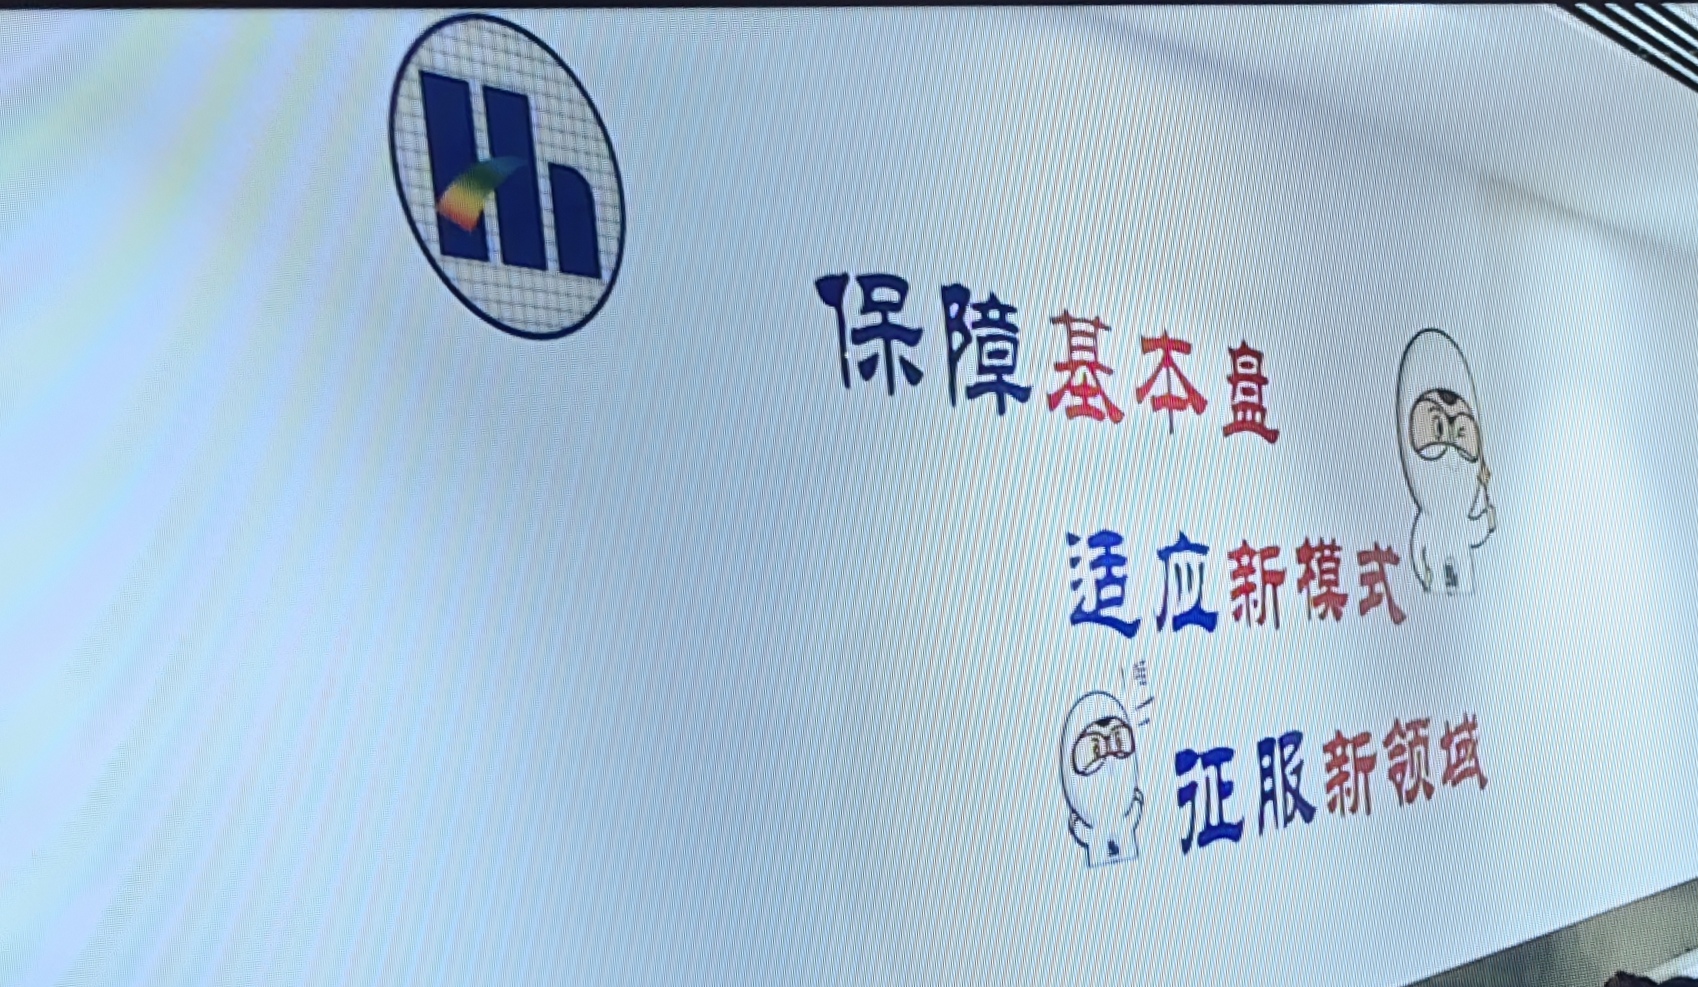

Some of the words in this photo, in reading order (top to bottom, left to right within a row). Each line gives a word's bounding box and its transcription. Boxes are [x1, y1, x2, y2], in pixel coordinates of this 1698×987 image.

[816, 272, 1280, 442] 保障基本盘
[1066, 530, 1407, 637] 适应新模式
[1175, 712, 1488, 853] 征服新领域
